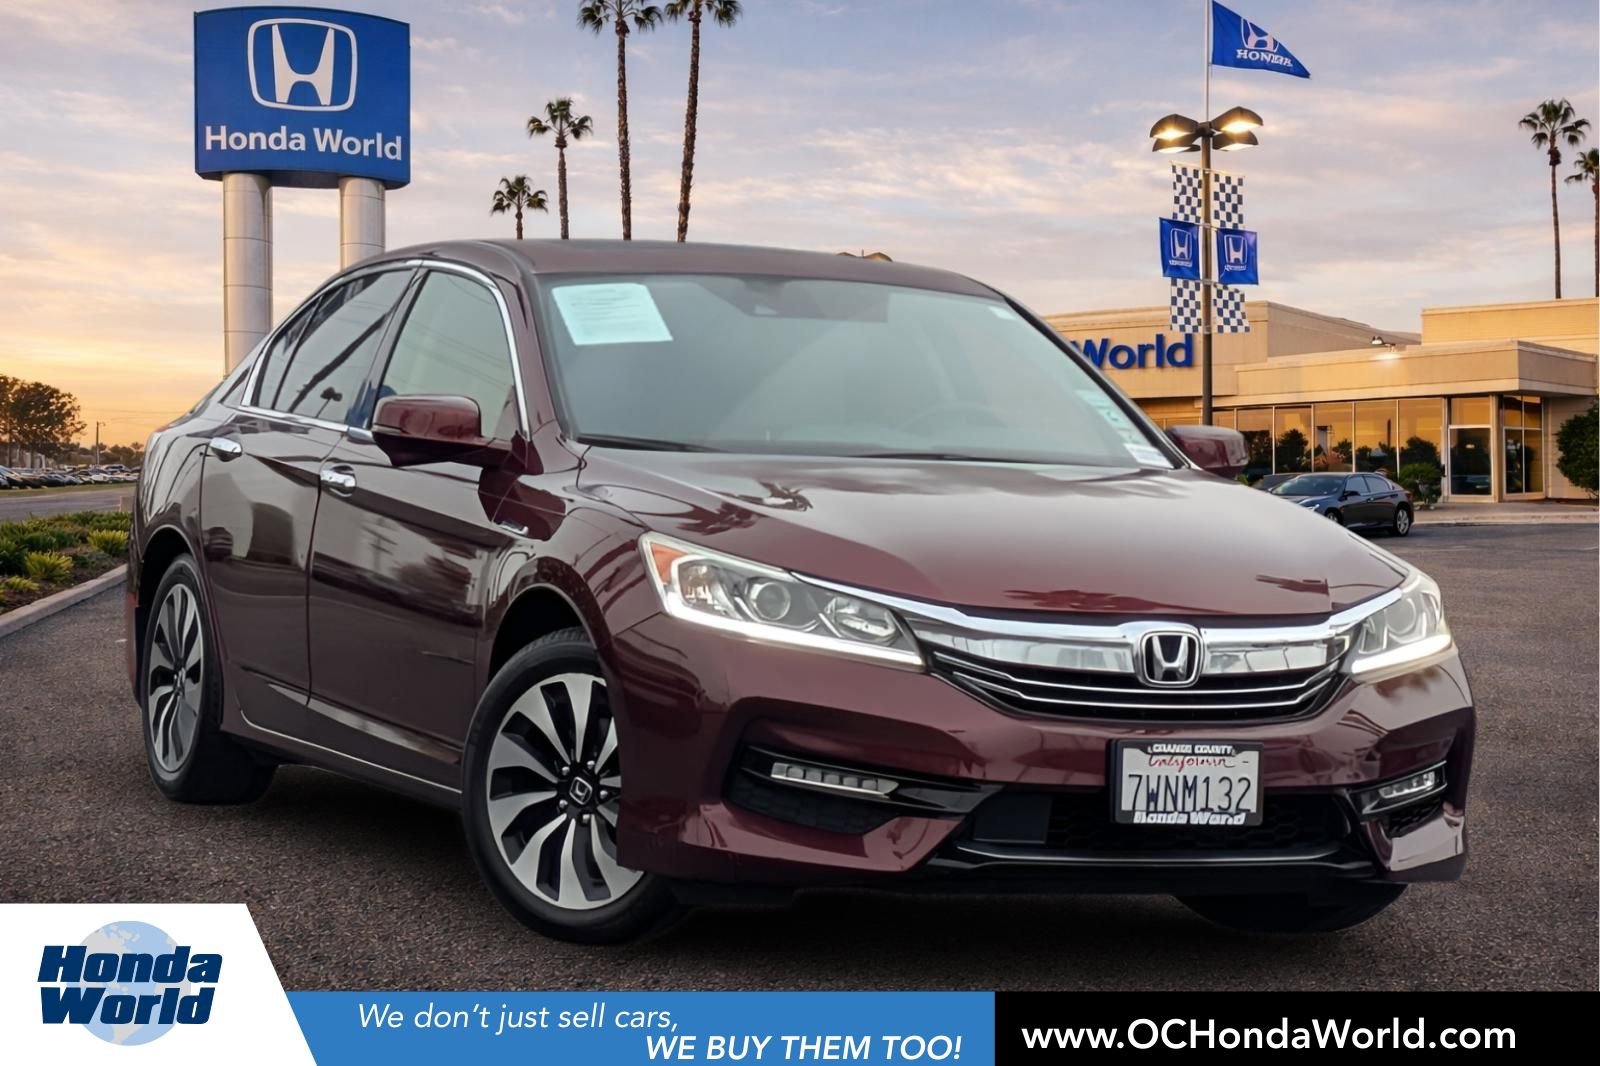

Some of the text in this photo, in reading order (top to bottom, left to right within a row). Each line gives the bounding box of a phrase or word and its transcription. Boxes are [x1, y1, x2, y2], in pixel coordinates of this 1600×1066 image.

[205, 125, 402, 160] Honda World
[1069, 333, 1193, 369] World
[1128, 774, 1252, 813] 7WNM132
